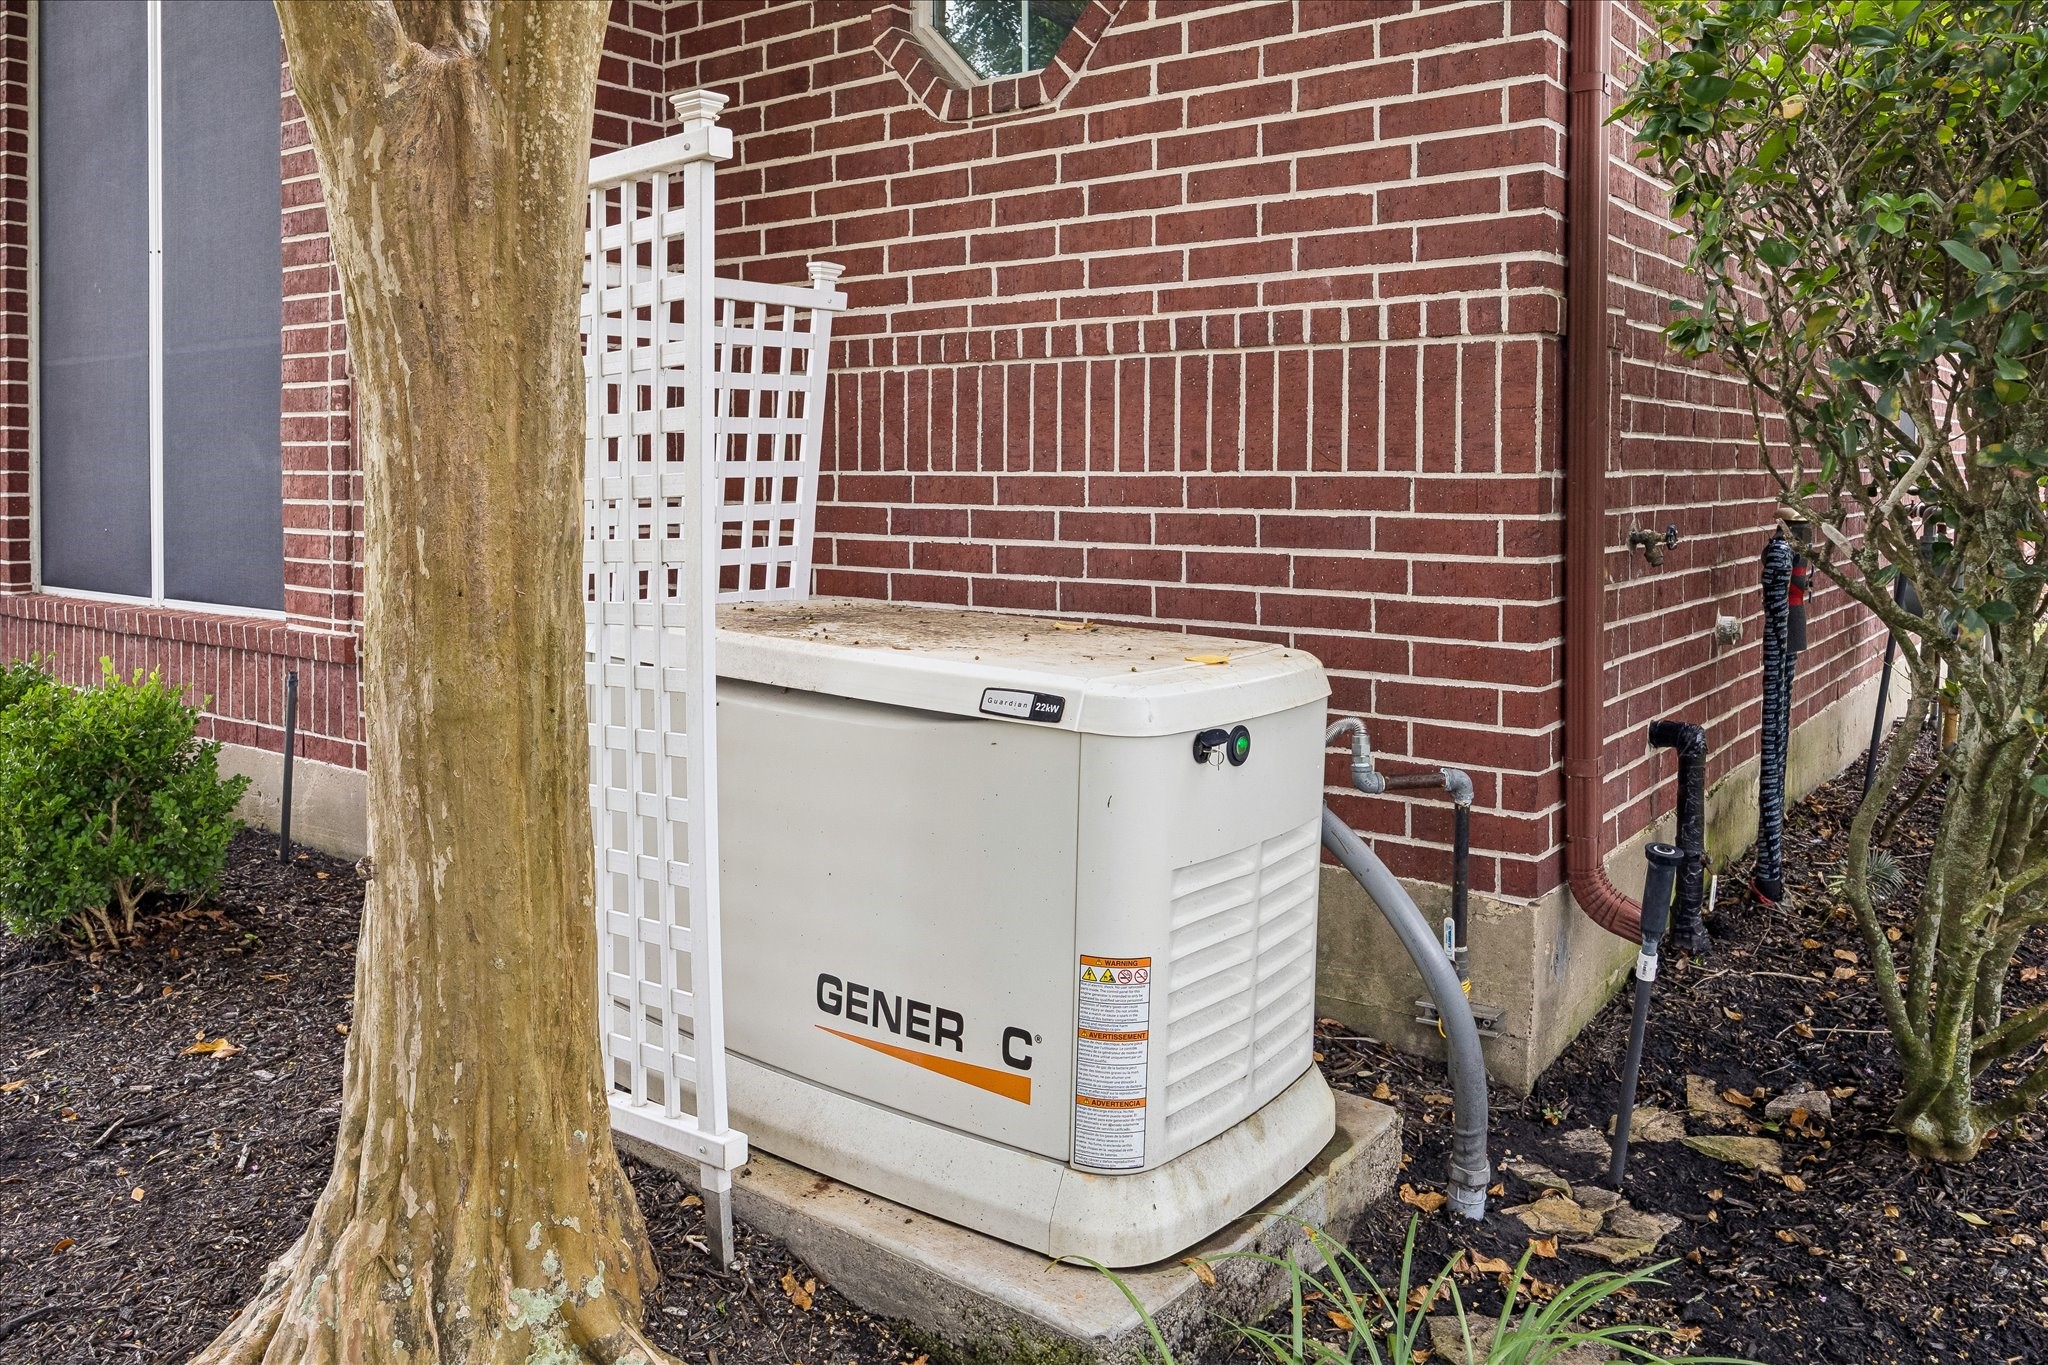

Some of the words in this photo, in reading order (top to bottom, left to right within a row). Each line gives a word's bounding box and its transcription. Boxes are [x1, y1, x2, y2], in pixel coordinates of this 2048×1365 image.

[987, 697, 1028, 709] Guardian
[1035, 702, 1060, 713] 22kW
[1089, 1032, 1146, 1040] AVERTISSEMENT
